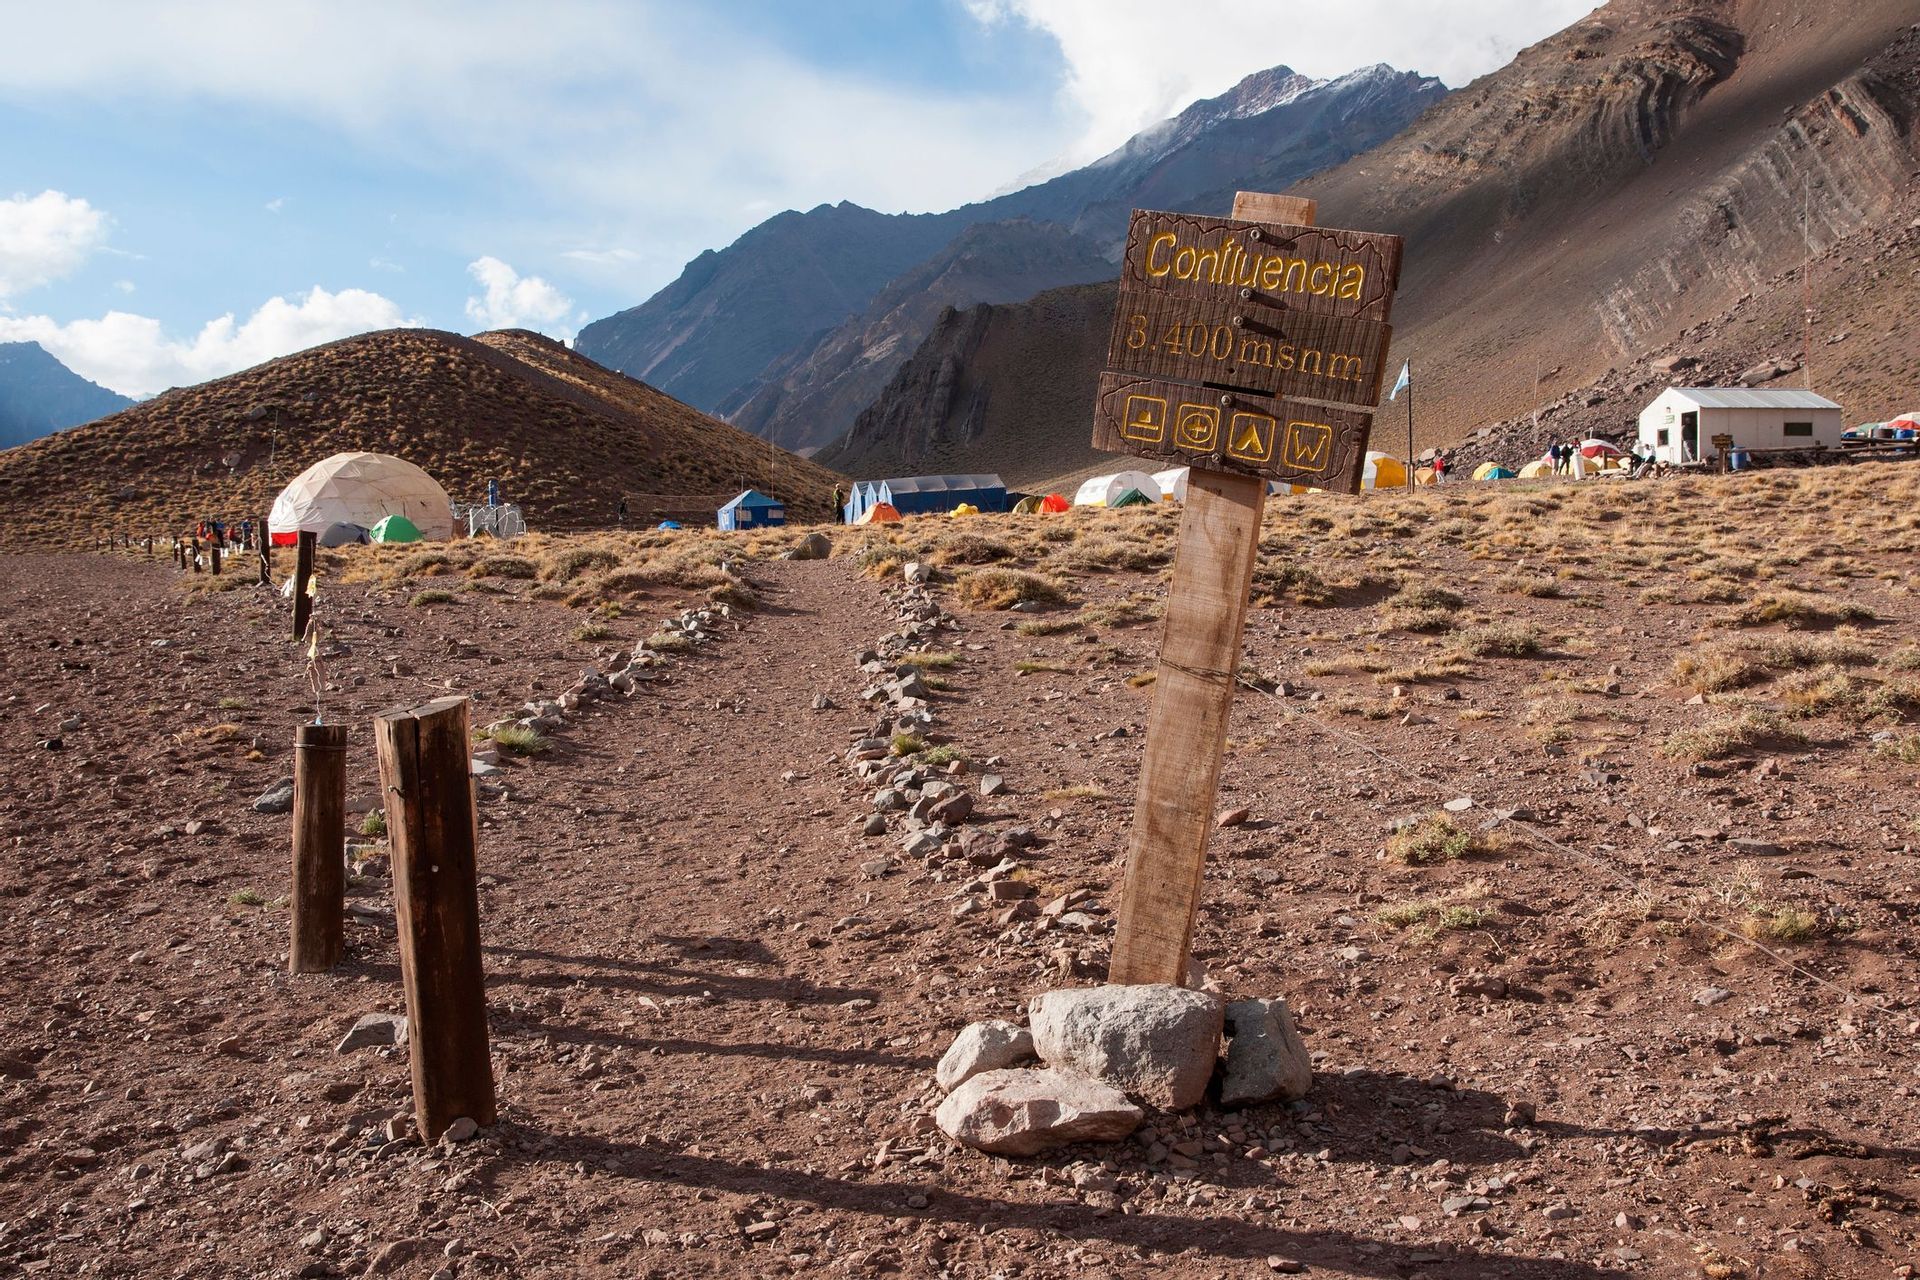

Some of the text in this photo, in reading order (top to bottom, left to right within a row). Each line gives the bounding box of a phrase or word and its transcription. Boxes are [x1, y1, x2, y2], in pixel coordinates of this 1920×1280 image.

[1145, 231, 1365, 301] Confluencia
[1127, 315, 1363, 382] 3.400 msnm
[1292, 430, 1328, 462] W
